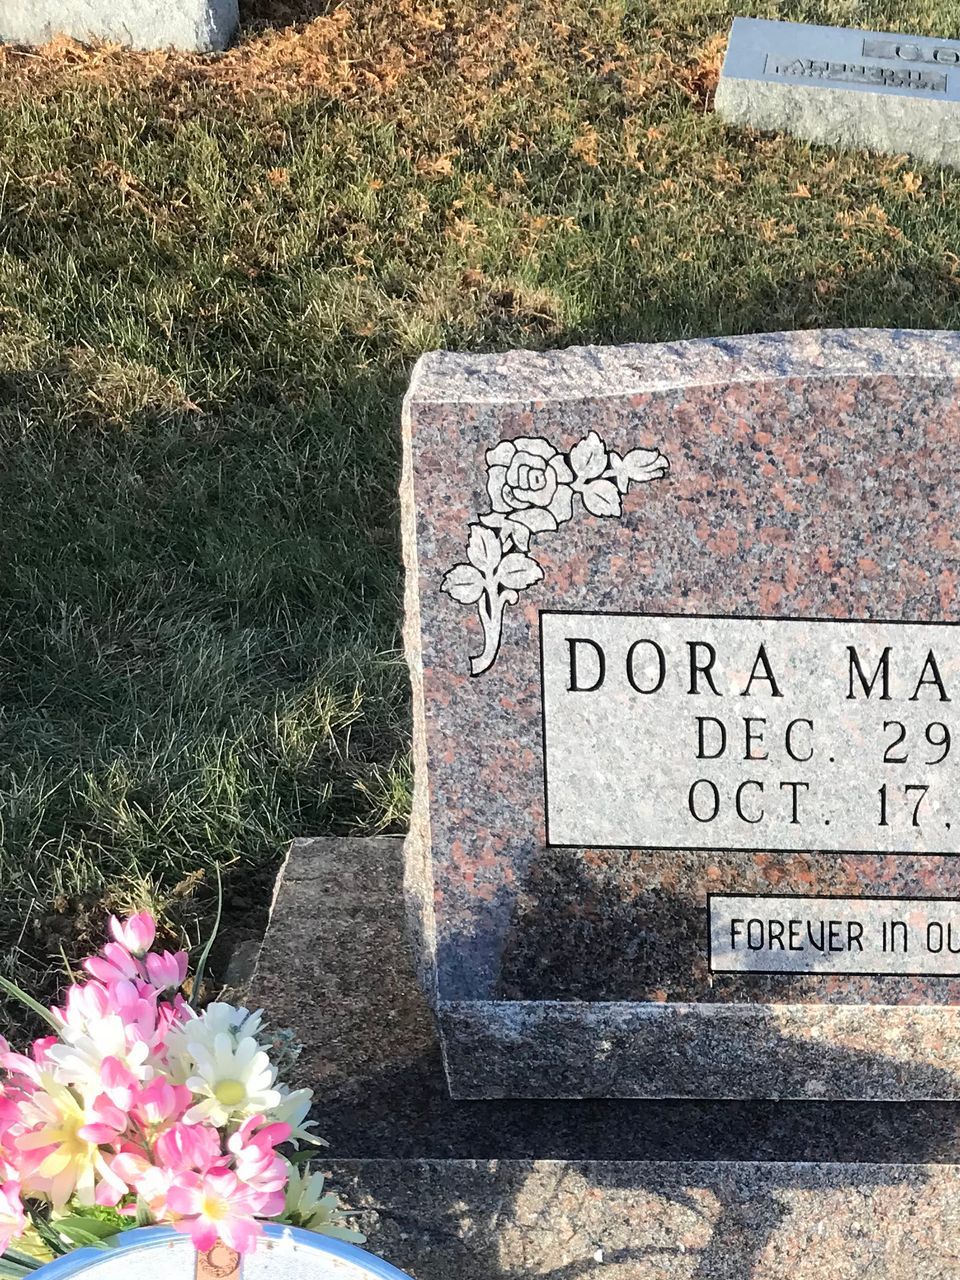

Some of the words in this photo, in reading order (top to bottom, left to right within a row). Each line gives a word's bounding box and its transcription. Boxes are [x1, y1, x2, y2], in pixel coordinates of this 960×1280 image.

[565, 638, 784, 698] DORA
[695, 716, 836, 763] DEC.
[688, 778, 831, 827] OCT.
[878, 783, 951, 831] 17,
[730, 918, 864, 953] FOREVER
[881, 920, 909, 954] IN
